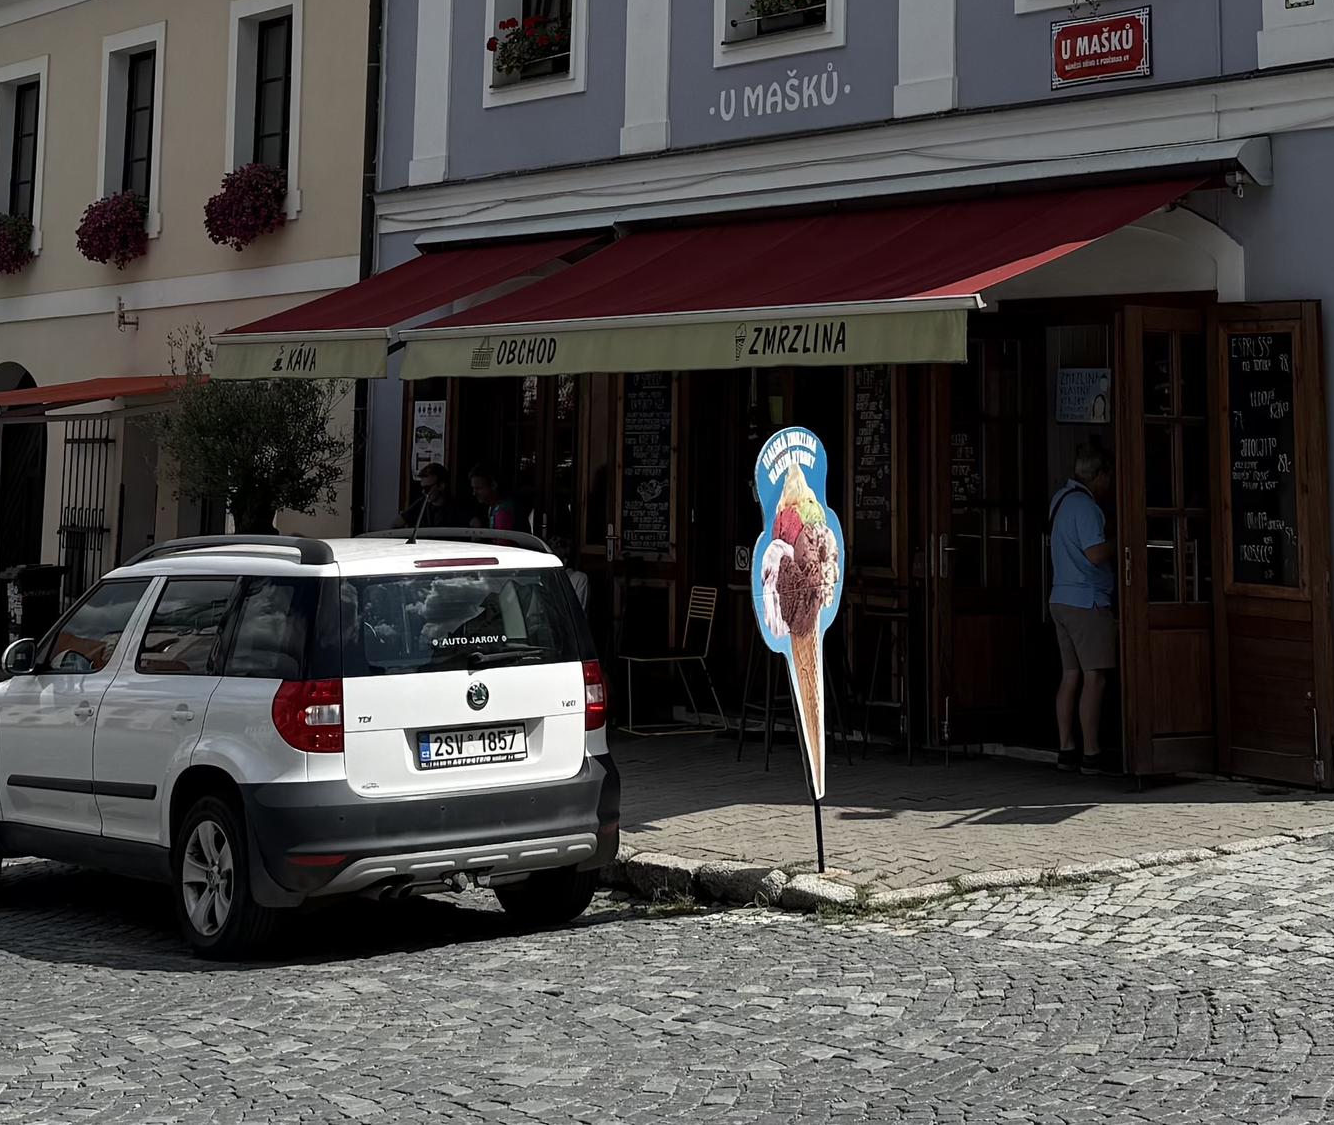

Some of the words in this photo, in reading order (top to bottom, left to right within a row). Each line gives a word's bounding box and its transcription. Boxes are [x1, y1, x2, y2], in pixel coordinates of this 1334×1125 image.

[1061, 39, 1071, 60] U
[1076, 23, 1133, 57] MAŠKŮ
[720, 89, 735, 121] U
[743, 62, 839, 117] MAŠKŮ
[496, 337, 557, 366] OBCHOD
[748, 321, 846, 355] ZMRZLINA
[286, 342, 317, 371] KÁVA
[441, 636, 467, 646] AUTO
[469, 635, 499, 645] JAROV
[434, 733, 464, 757] 2SV
[478, 729, 517, 753] 1857
